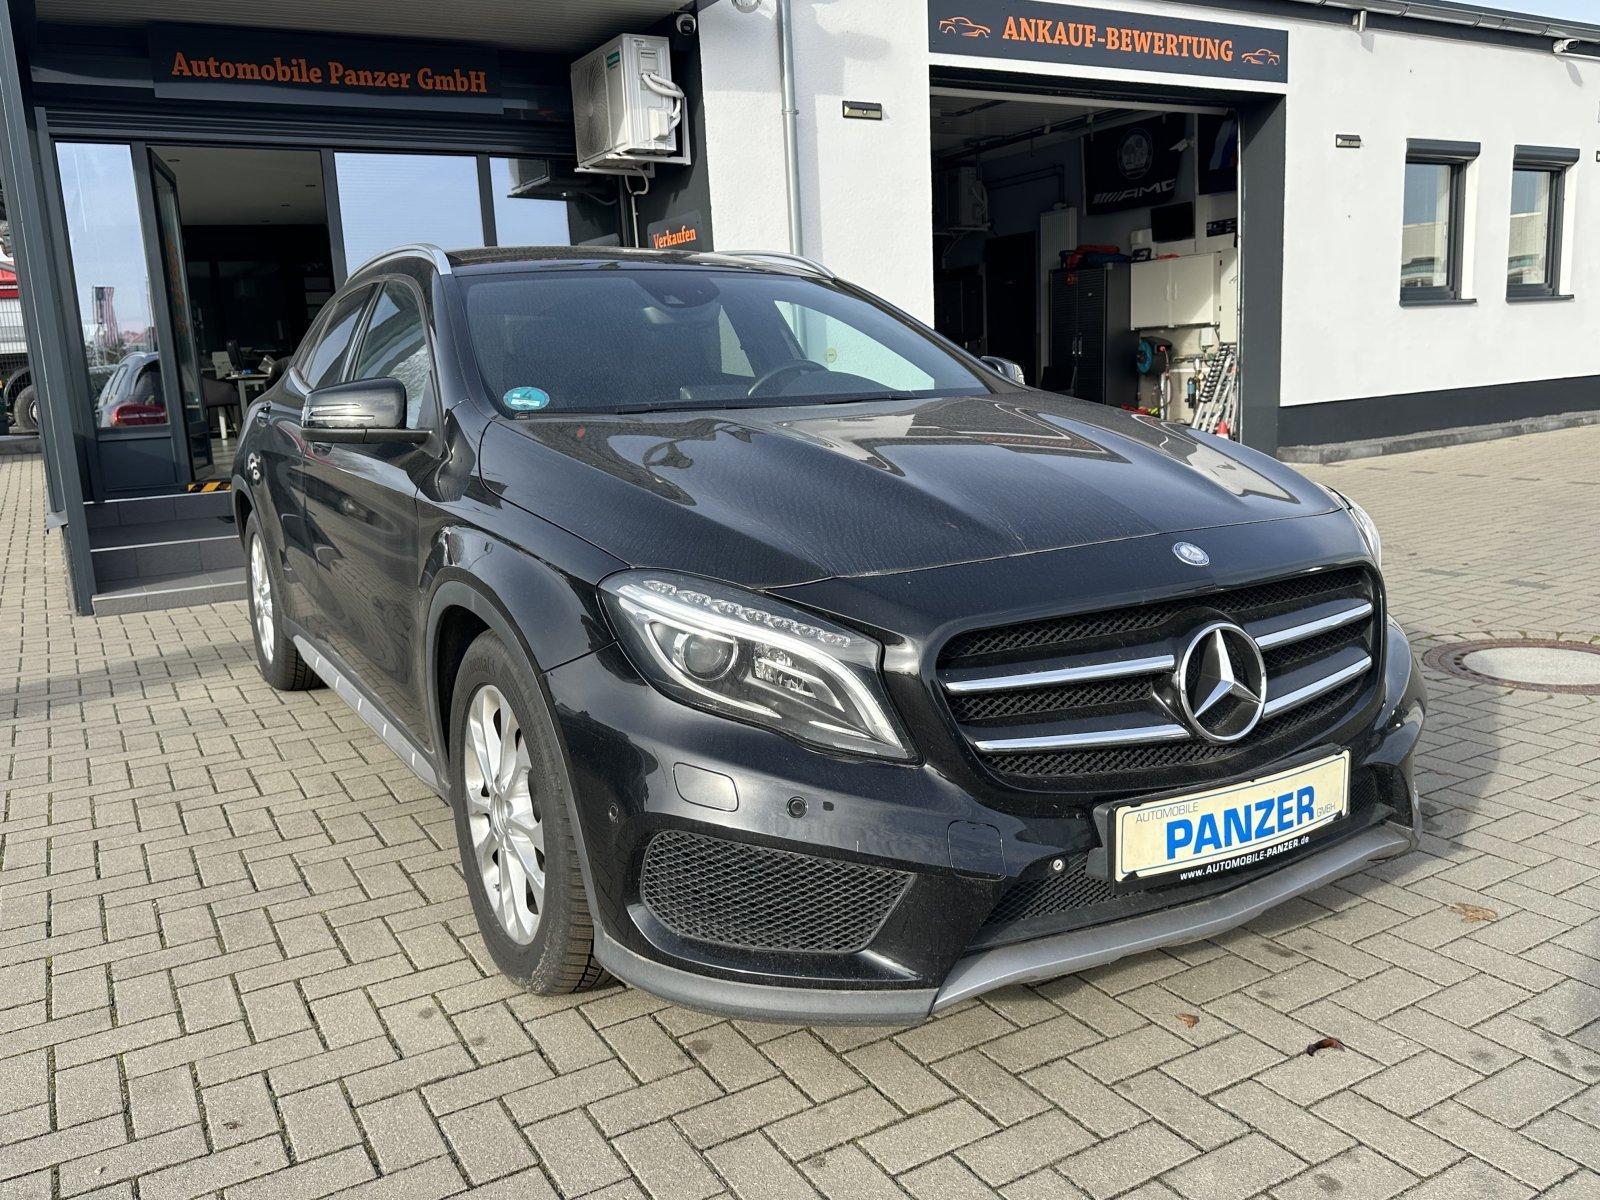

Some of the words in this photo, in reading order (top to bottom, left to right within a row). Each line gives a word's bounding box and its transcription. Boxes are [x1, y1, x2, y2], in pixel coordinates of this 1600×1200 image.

[1002, 15, 1234, 62] ANKAUF-BEWERTUNG
[171, 52, 322, 84] Automobile
[328, 61, 411, 89] Panzer
[416, 67, 487, 93] GmbH
[653, 225, 697, 249] Verkaufen
[1135, 801, 1200, 824] AUTOMOBILE
[1166, 785, 1315, 860] PANZER
[1316, 801, 1336, 818] GMBH
[1180, 836, 1310, 881] www.AUTOMOBILE-PANZER.de
